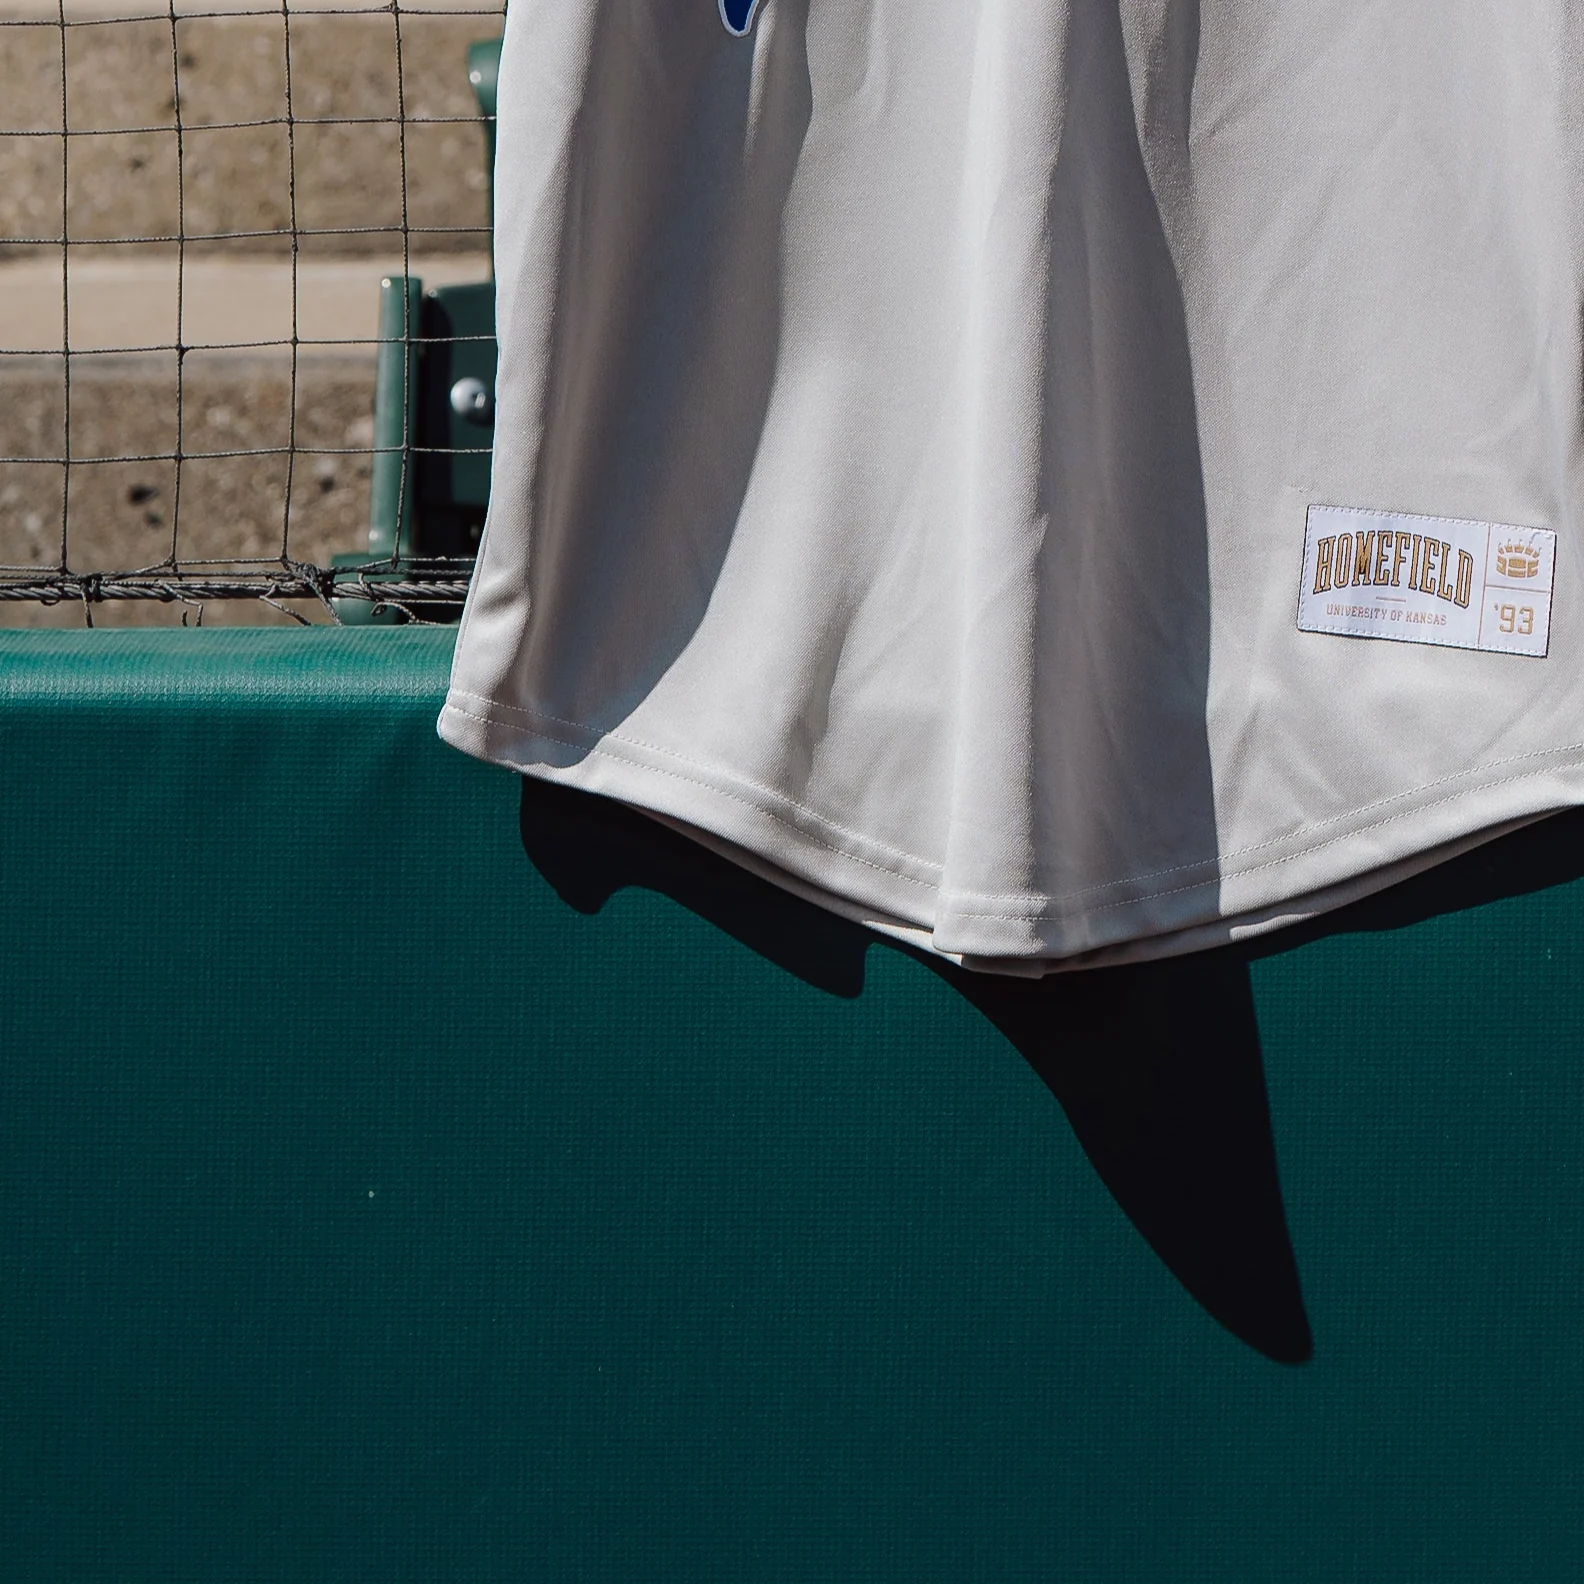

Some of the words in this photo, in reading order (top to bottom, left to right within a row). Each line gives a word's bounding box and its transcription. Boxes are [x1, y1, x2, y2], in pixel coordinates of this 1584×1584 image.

[1312, 530, 1474, 609] HOMEFIELD
[1326, 604, 1388, 621] UNIVERSITY
[1391, 610, 1404, 622] OF
[1405, 611, 1447, 626] KANSAS
